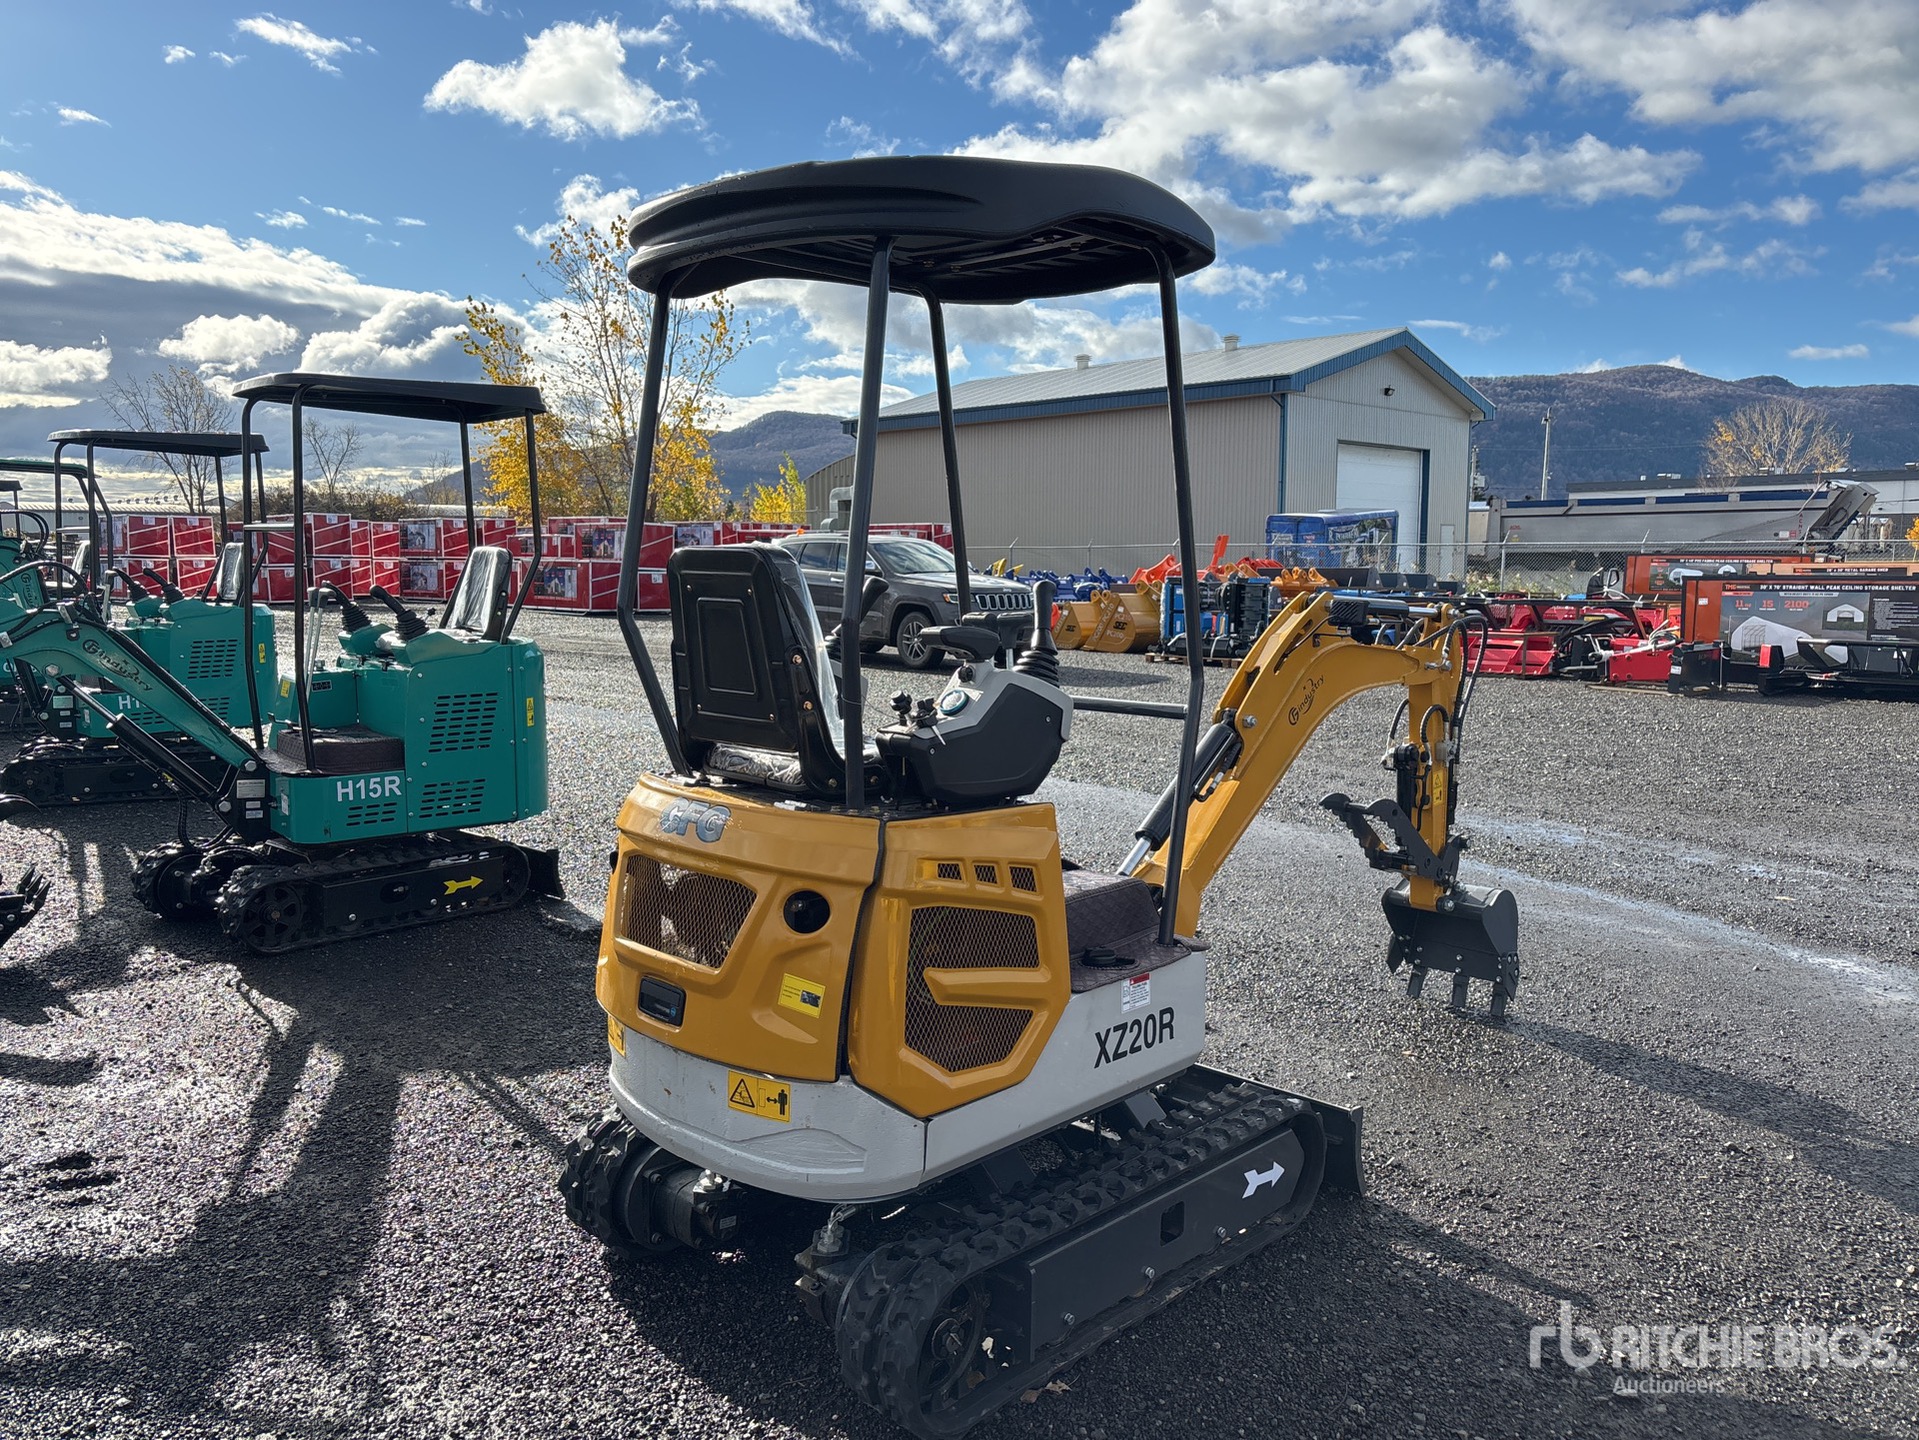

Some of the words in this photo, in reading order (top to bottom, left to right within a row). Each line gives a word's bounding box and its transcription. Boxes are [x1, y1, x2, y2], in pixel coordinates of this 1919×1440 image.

[1784, 600, 1810, 608] 2100
[336, 775, 402, 802] H15R
[1094, 1006, 1175, 1068] XZ20R
